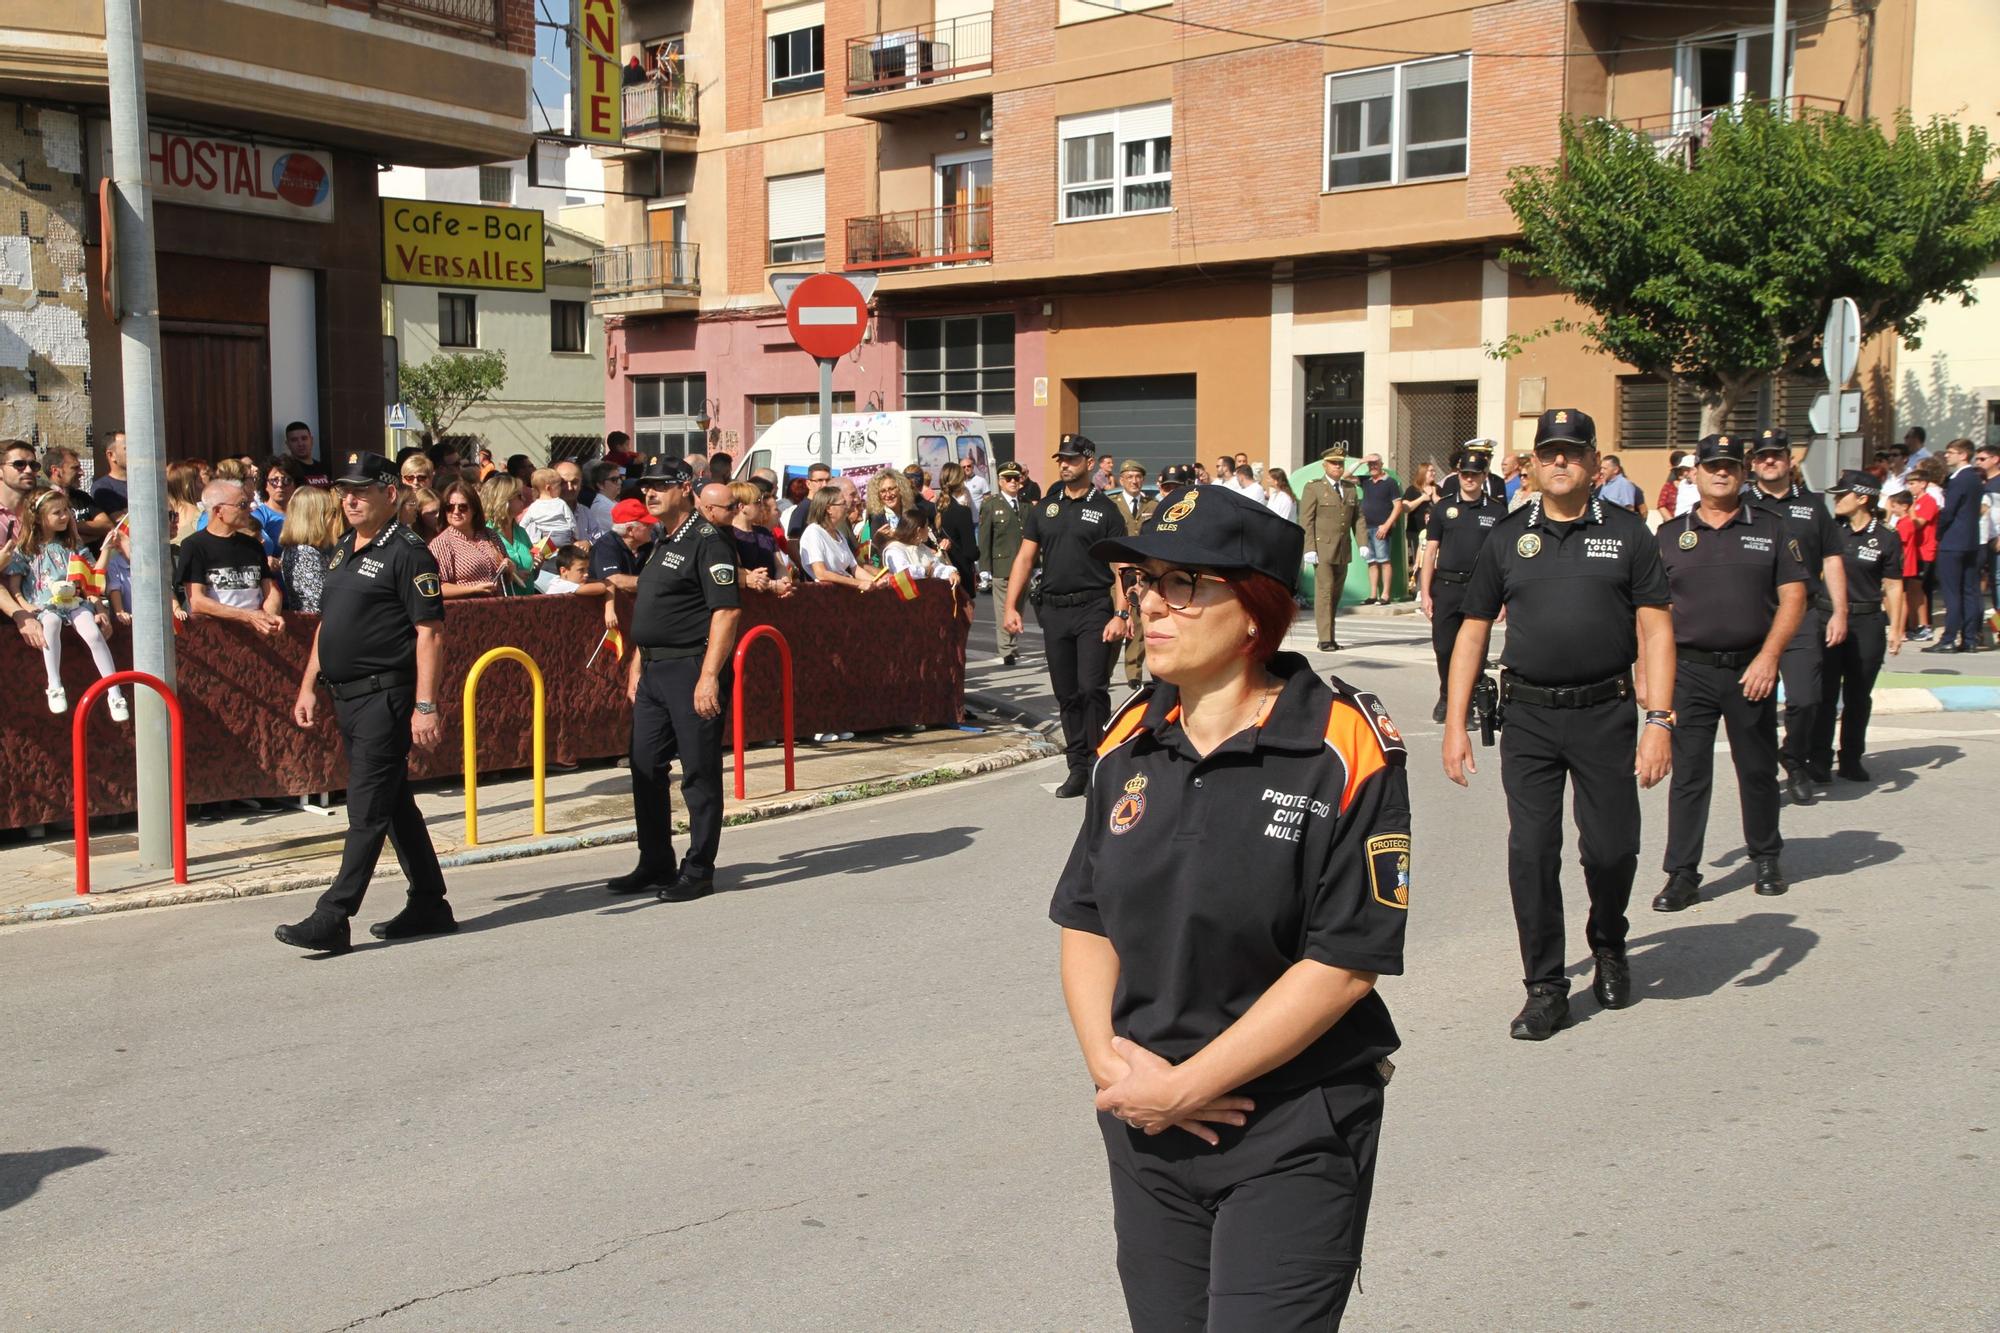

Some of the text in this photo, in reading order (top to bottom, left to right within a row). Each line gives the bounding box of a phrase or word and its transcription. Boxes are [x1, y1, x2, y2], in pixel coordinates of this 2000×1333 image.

[149, 132, 278, 200] HOSTAL
[1584, 538, 1622, 546] POLICIA
[1273, 809, 1304, 825] CIVI
[1264, 823, 1302, 843] NULE
